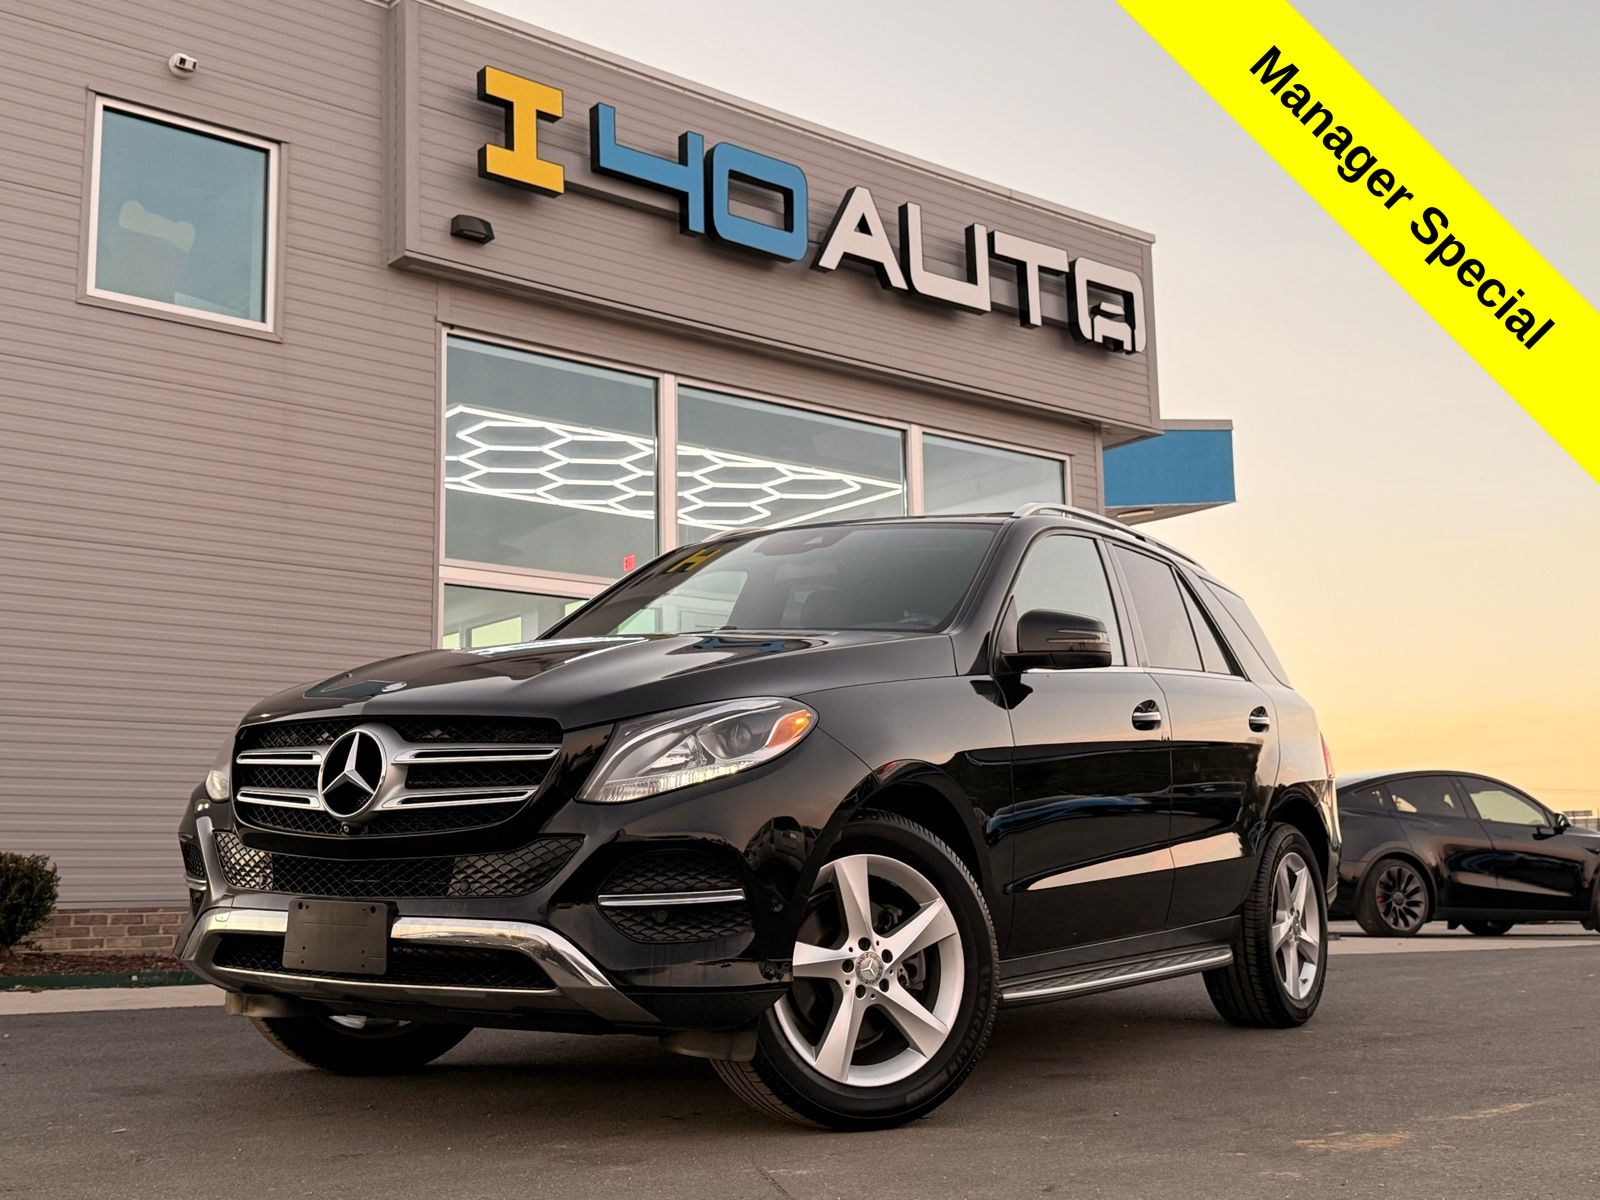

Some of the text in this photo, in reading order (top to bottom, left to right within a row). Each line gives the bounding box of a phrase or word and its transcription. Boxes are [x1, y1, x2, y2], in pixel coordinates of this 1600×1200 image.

[478, 65, 1147, 354] I 40 AUTO
